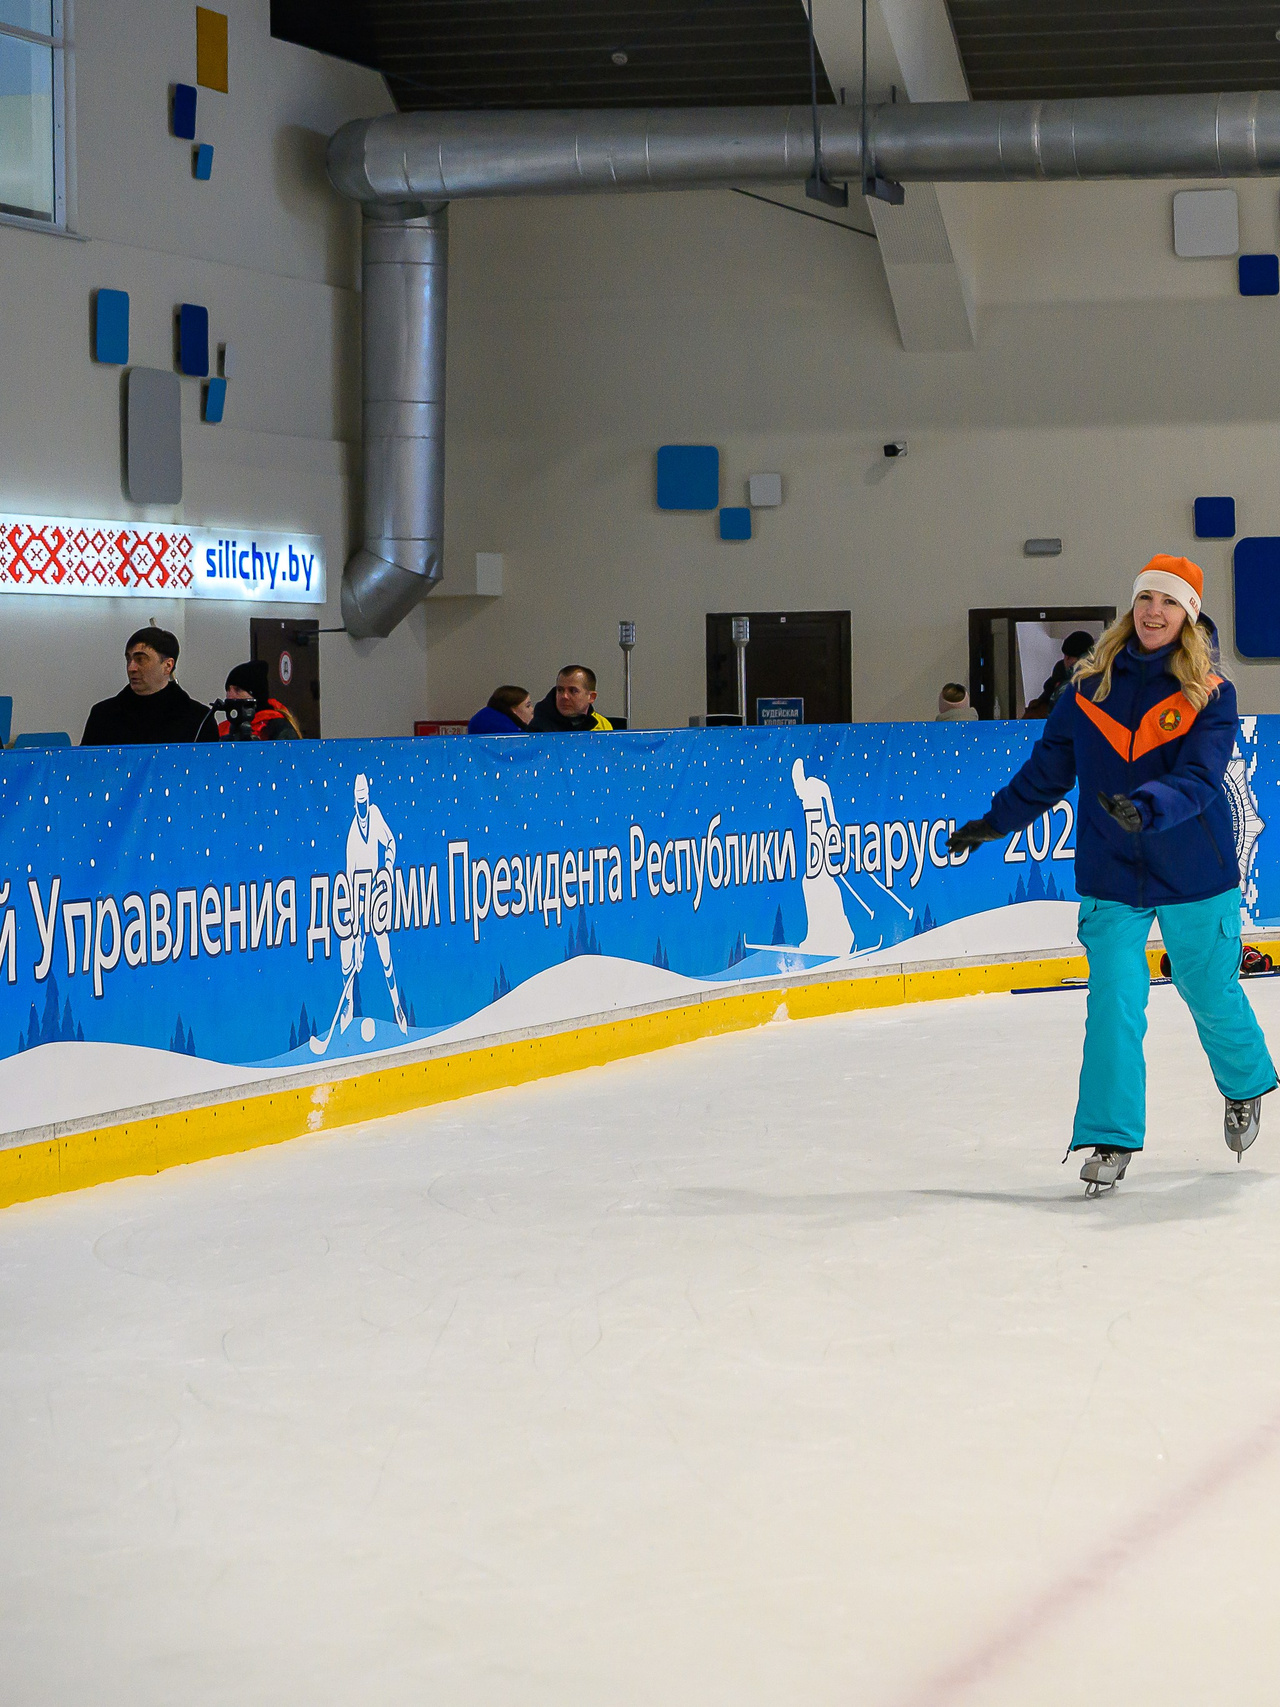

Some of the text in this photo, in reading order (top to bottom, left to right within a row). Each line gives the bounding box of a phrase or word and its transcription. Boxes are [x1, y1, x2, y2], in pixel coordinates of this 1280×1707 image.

[206, 540, 315, 592] silichy.by
[761, 708, 799, 718] СУДЕЙСКАЯ
[28, 877, 297, 997] Управления
[308, 865, 440, 960] делами
[448, 840, 623, 942] Президента
[630, 813, 797, 911] Республики
[804, 809, 970, 889] Беларусь
